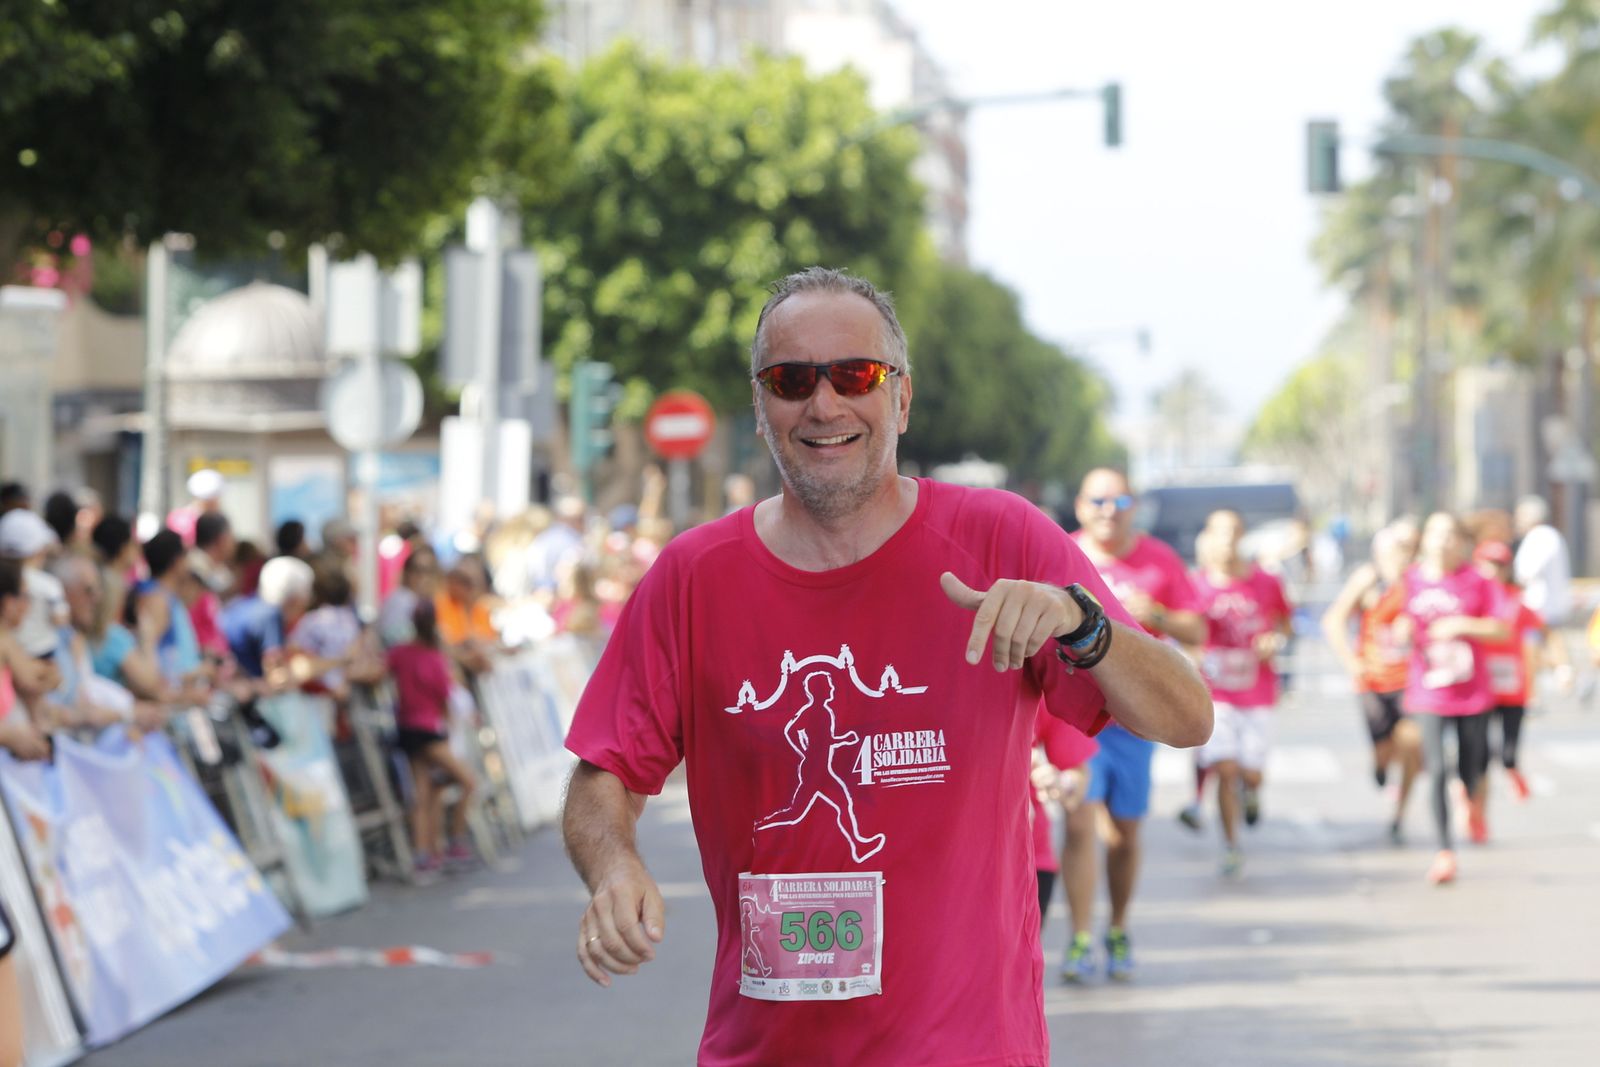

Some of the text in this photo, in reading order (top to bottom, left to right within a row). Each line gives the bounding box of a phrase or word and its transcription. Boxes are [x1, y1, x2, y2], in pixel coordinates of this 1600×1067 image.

[873, 729, 946, 751] CARRERA
[852, 735, 877, 785] 4
[873, 747, 947, 767] SOLIDARIA
[769, 880, 873, 902] 4 CARRERA SOLIDARIA
[779, 910, 863, 952] 566
[797, 953, 835, 965] ZIPOTE
